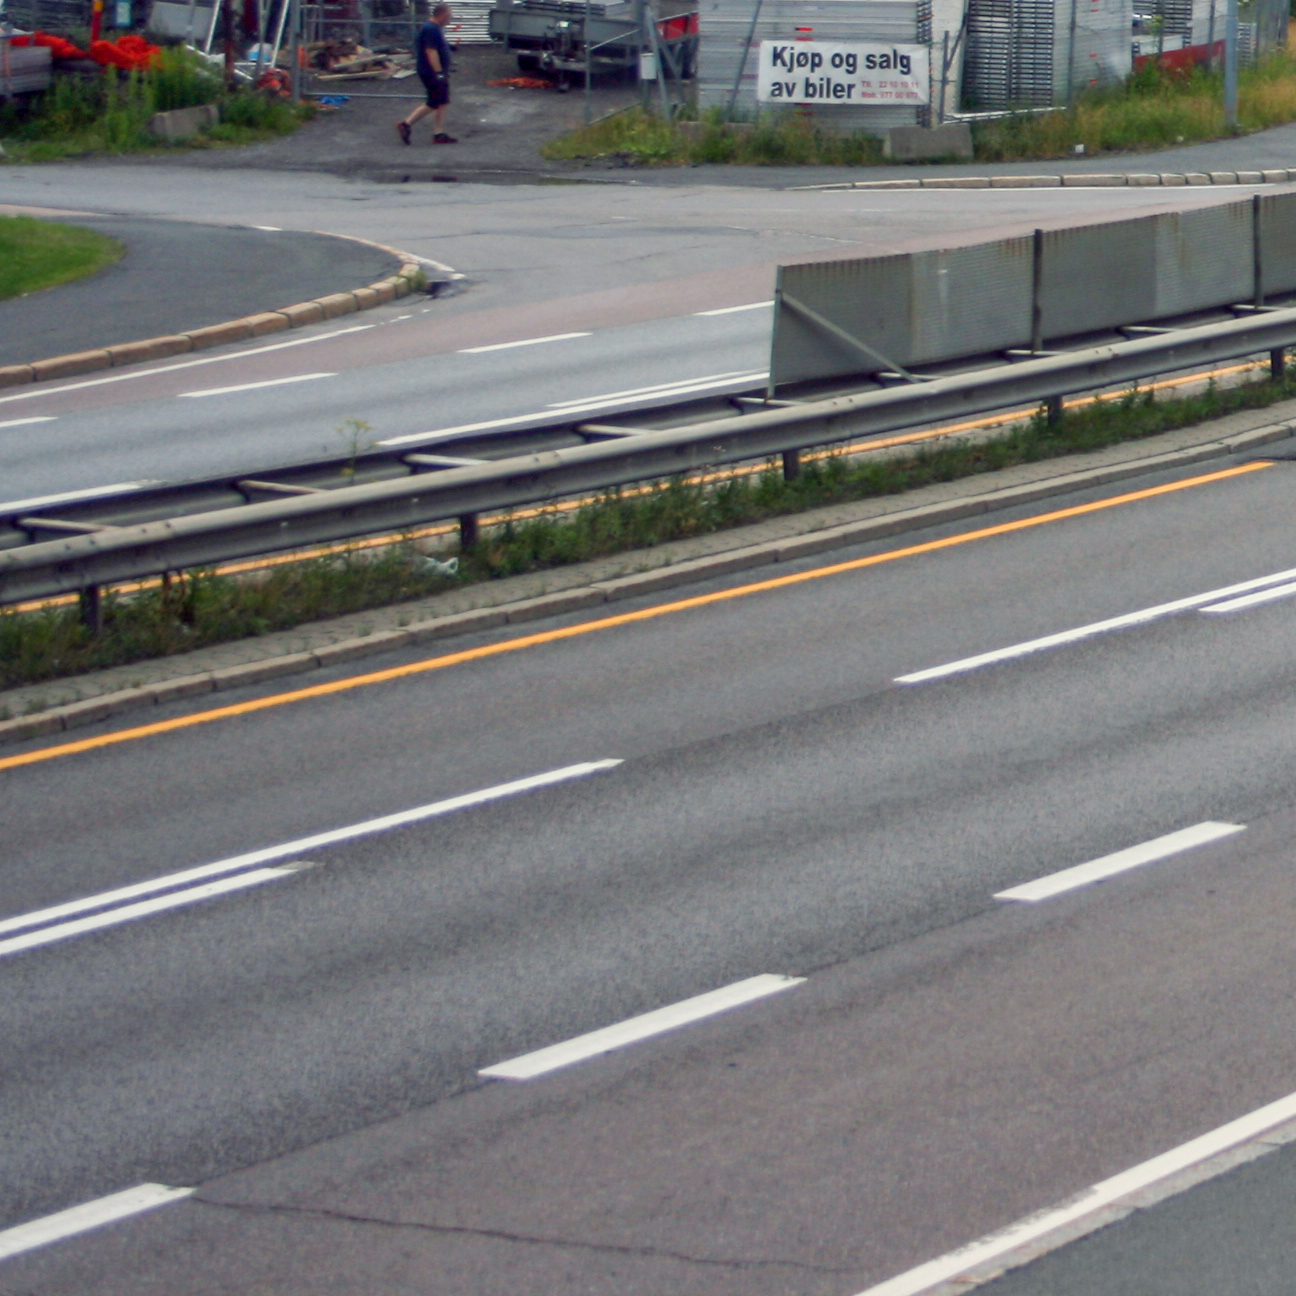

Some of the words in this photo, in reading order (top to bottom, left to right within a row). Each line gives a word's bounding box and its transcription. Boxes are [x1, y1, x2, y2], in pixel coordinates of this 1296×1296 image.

[772, 46, 823, 73] Kjøp
[831, 52, 858, 75] og
[865, 49, 912, 75] salg
[770, 81, 797, 98] av
[805, 77, 856, 99] biler
